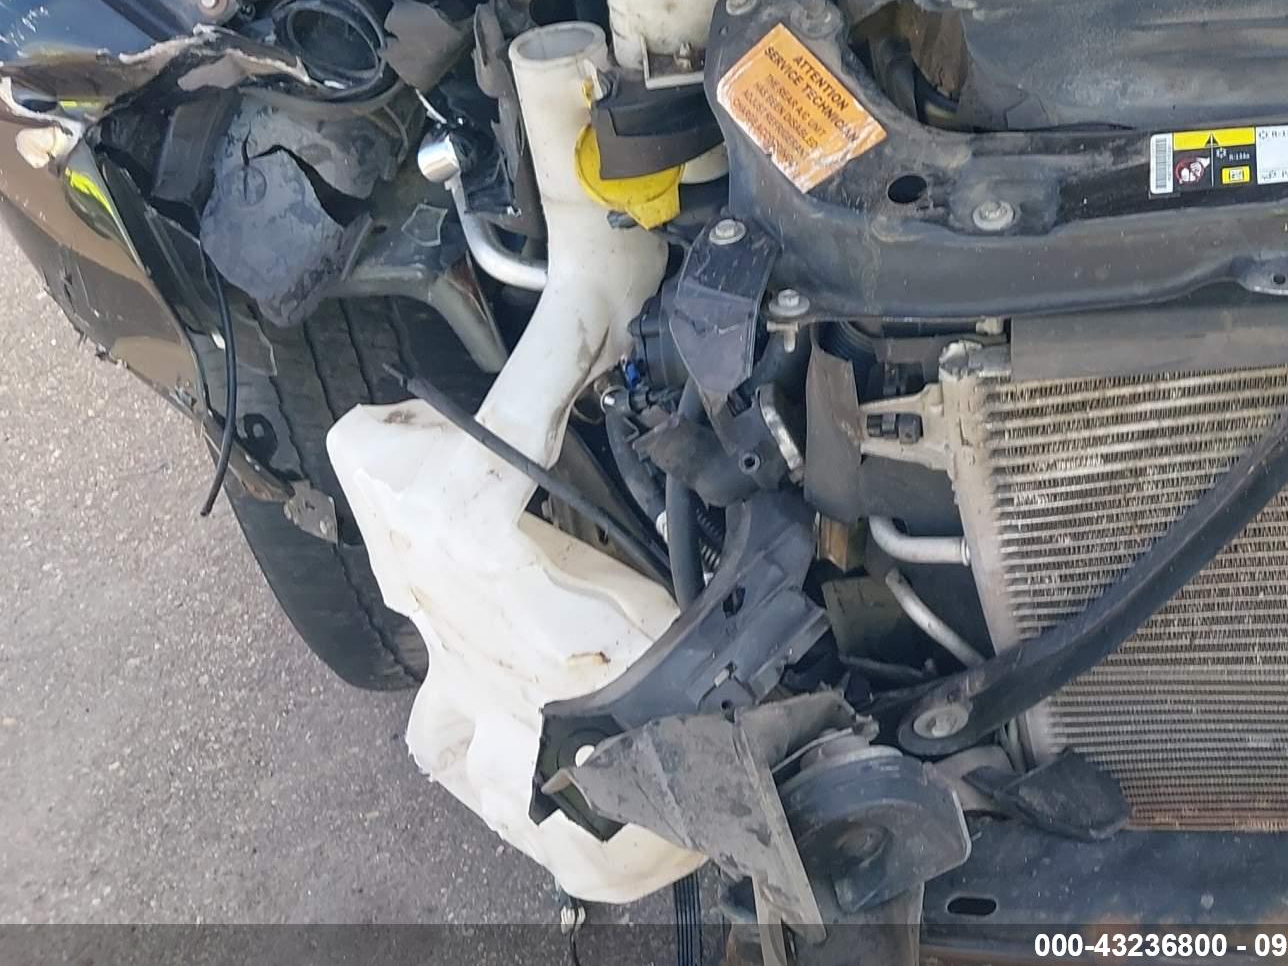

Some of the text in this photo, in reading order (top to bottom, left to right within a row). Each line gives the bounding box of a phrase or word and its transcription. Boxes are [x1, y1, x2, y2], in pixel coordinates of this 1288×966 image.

[763, 44, 859, 144] SERVICE TECHNICIAN
[792, 52, 850, 112] ATTENTION
